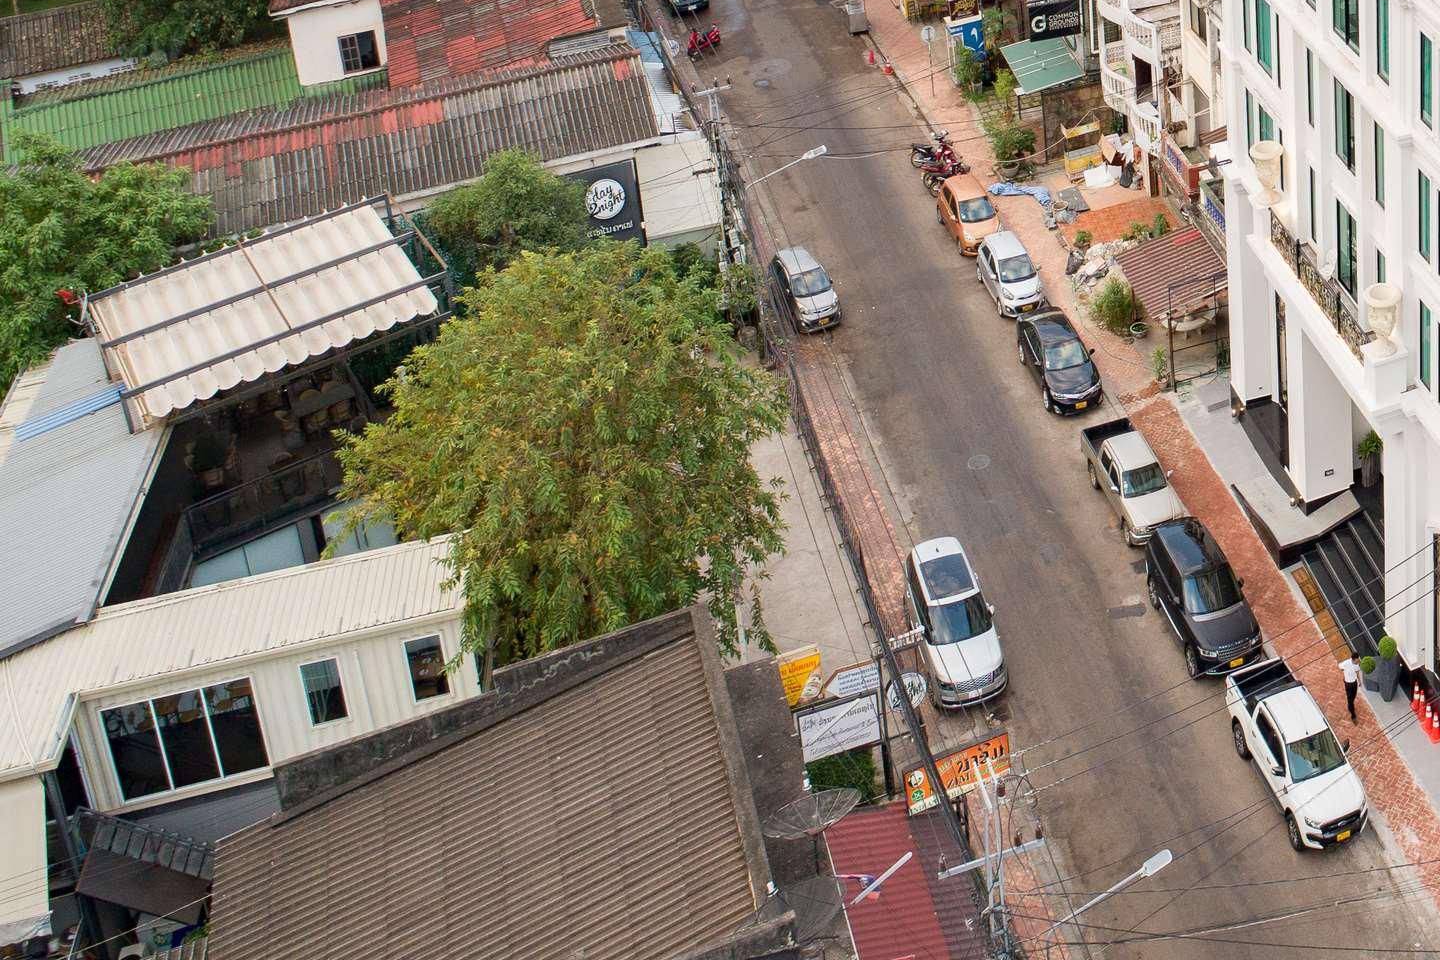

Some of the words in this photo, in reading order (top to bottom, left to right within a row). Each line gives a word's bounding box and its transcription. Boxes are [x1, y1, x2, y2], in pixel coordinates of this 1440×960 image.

[1048, 10, 1079, 21] COMMON
[1048, 16, 1079, 28] GROUNDS
[593, 185, 613, 203] day
[590, 189, 626, 216] 2night
